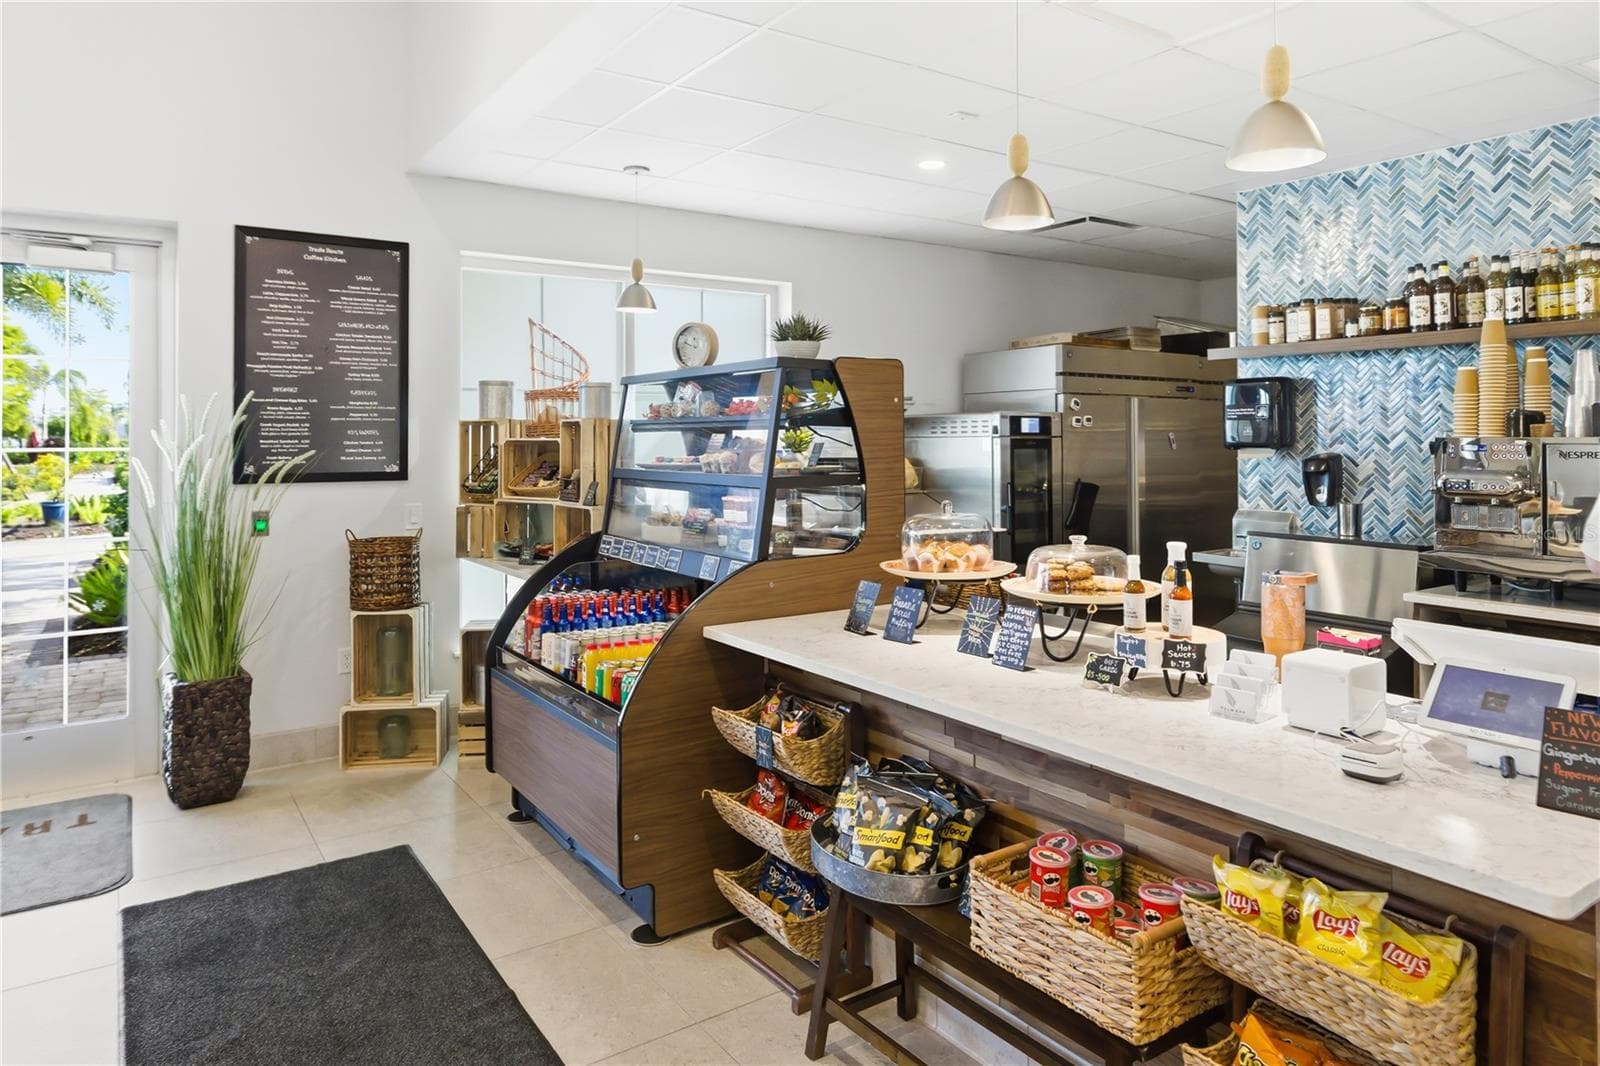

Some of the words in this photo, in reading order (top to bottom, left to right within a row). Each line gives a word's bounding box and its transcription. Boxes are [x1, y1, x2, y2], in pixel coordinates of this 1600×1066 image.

[303, 253, 323, 261] Coffee
[1558, 450, 1600, 460] NESPRE
[1176, 643, 1192, 652] Hot
[1168, 649, 1198, 660] Sauces
[855, 829, 900, 845] Smartfood
[1317, 911, 1360, 936] Lay's
[1382, 942, 1430, 977] Lay's
